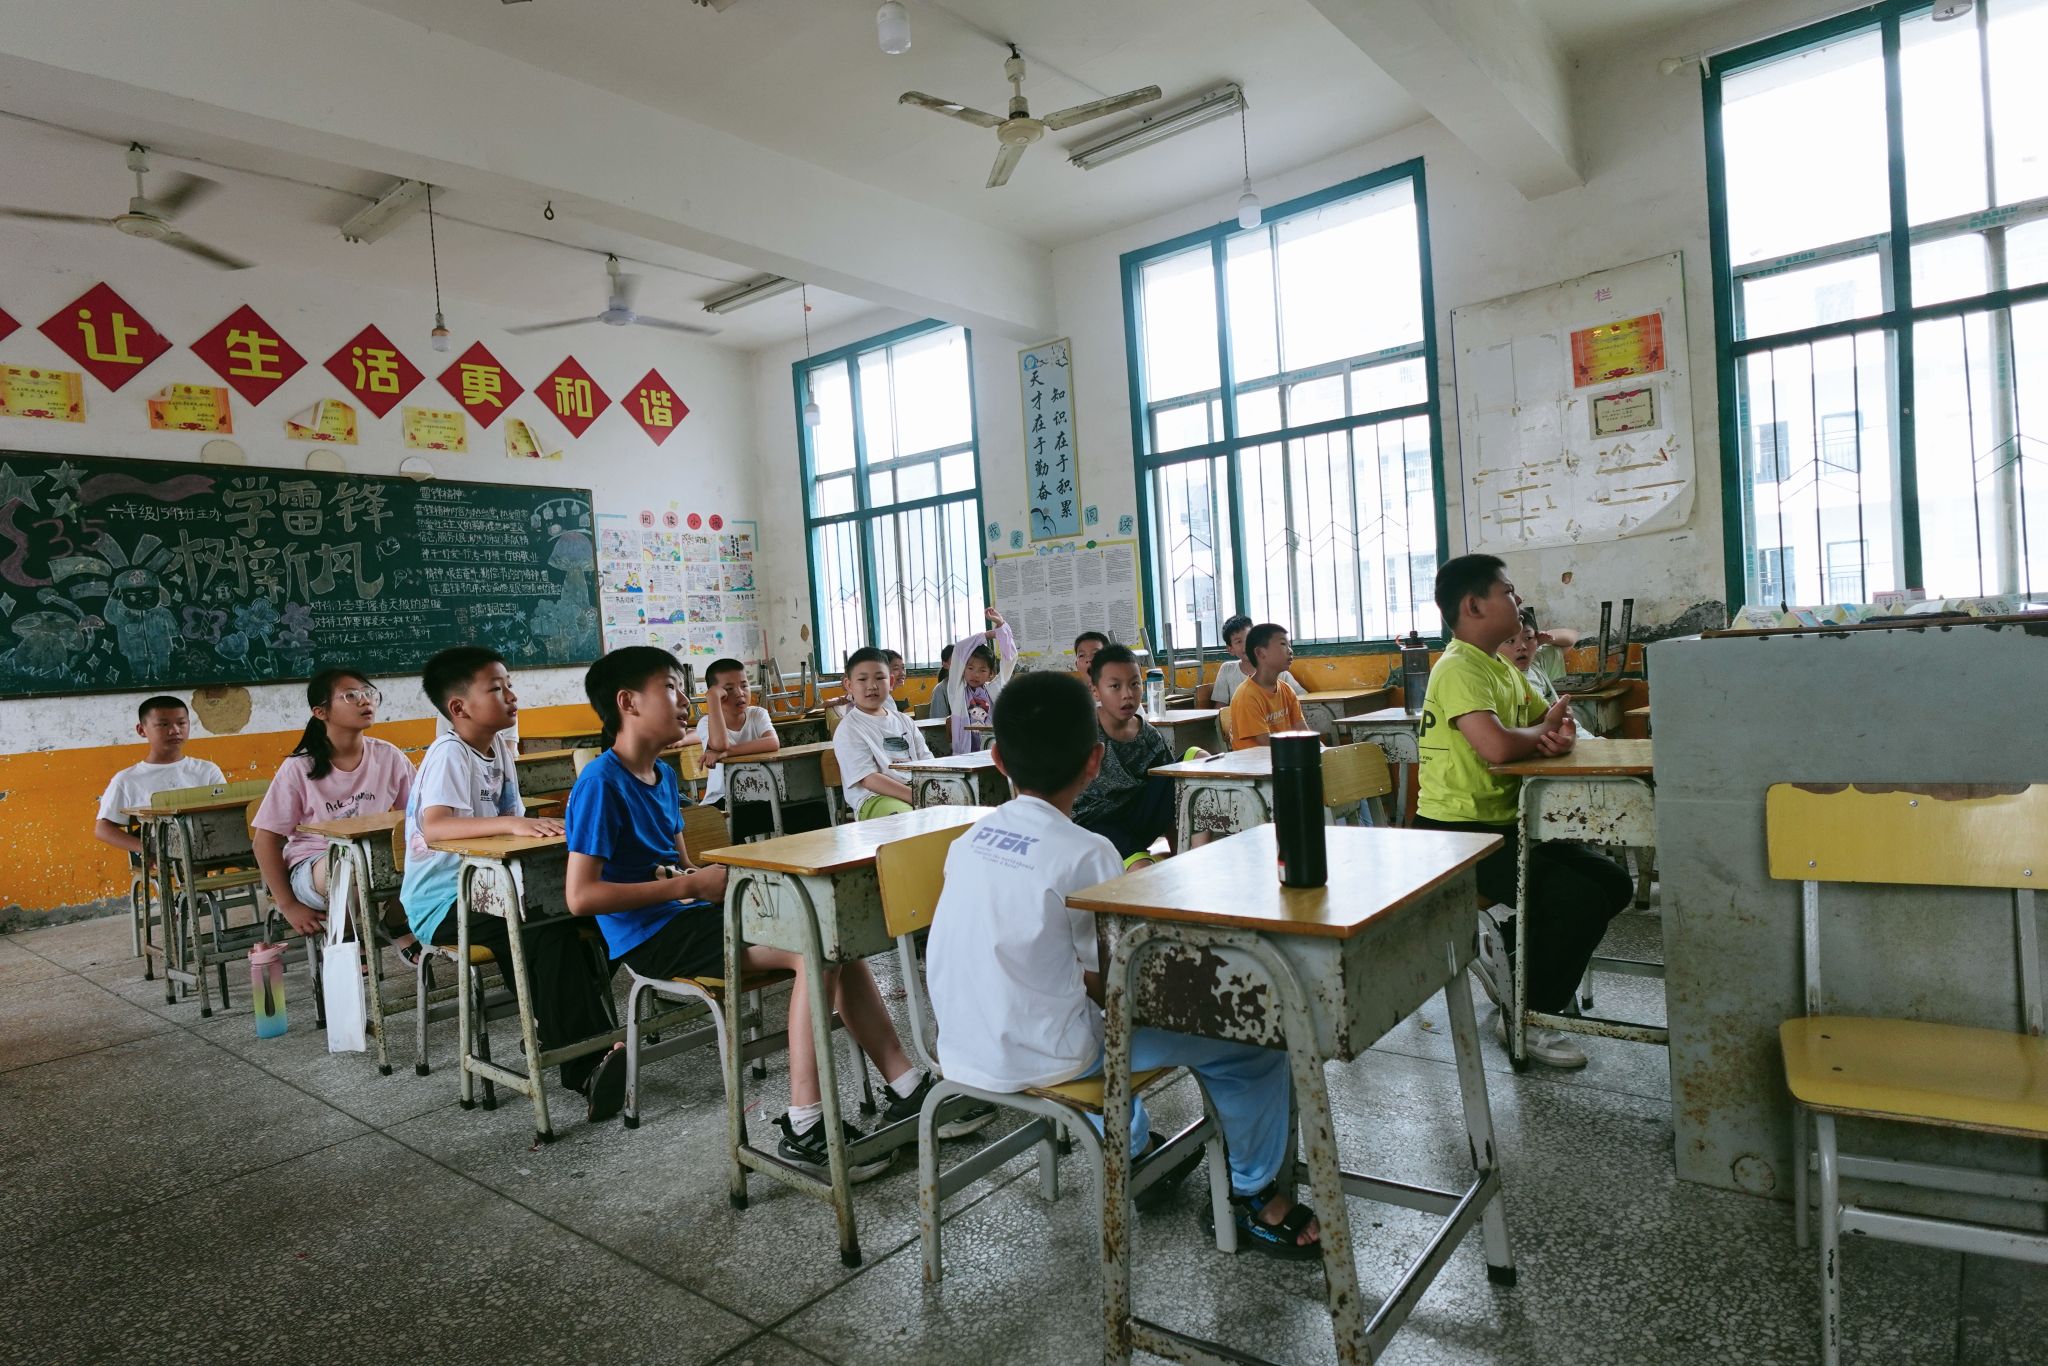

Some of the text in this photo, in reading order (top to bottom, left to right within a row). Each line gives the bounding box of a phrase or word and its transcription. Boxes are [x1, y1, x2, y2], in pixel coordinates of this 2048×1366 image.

[1030, 370, 1052, 501] 天才在于勤奋
[1051, 387, 1073, 518] 知识在于积累
[223, 476, 394, 538] 学雷锋
[165, 529, 386, 606] 树新风
